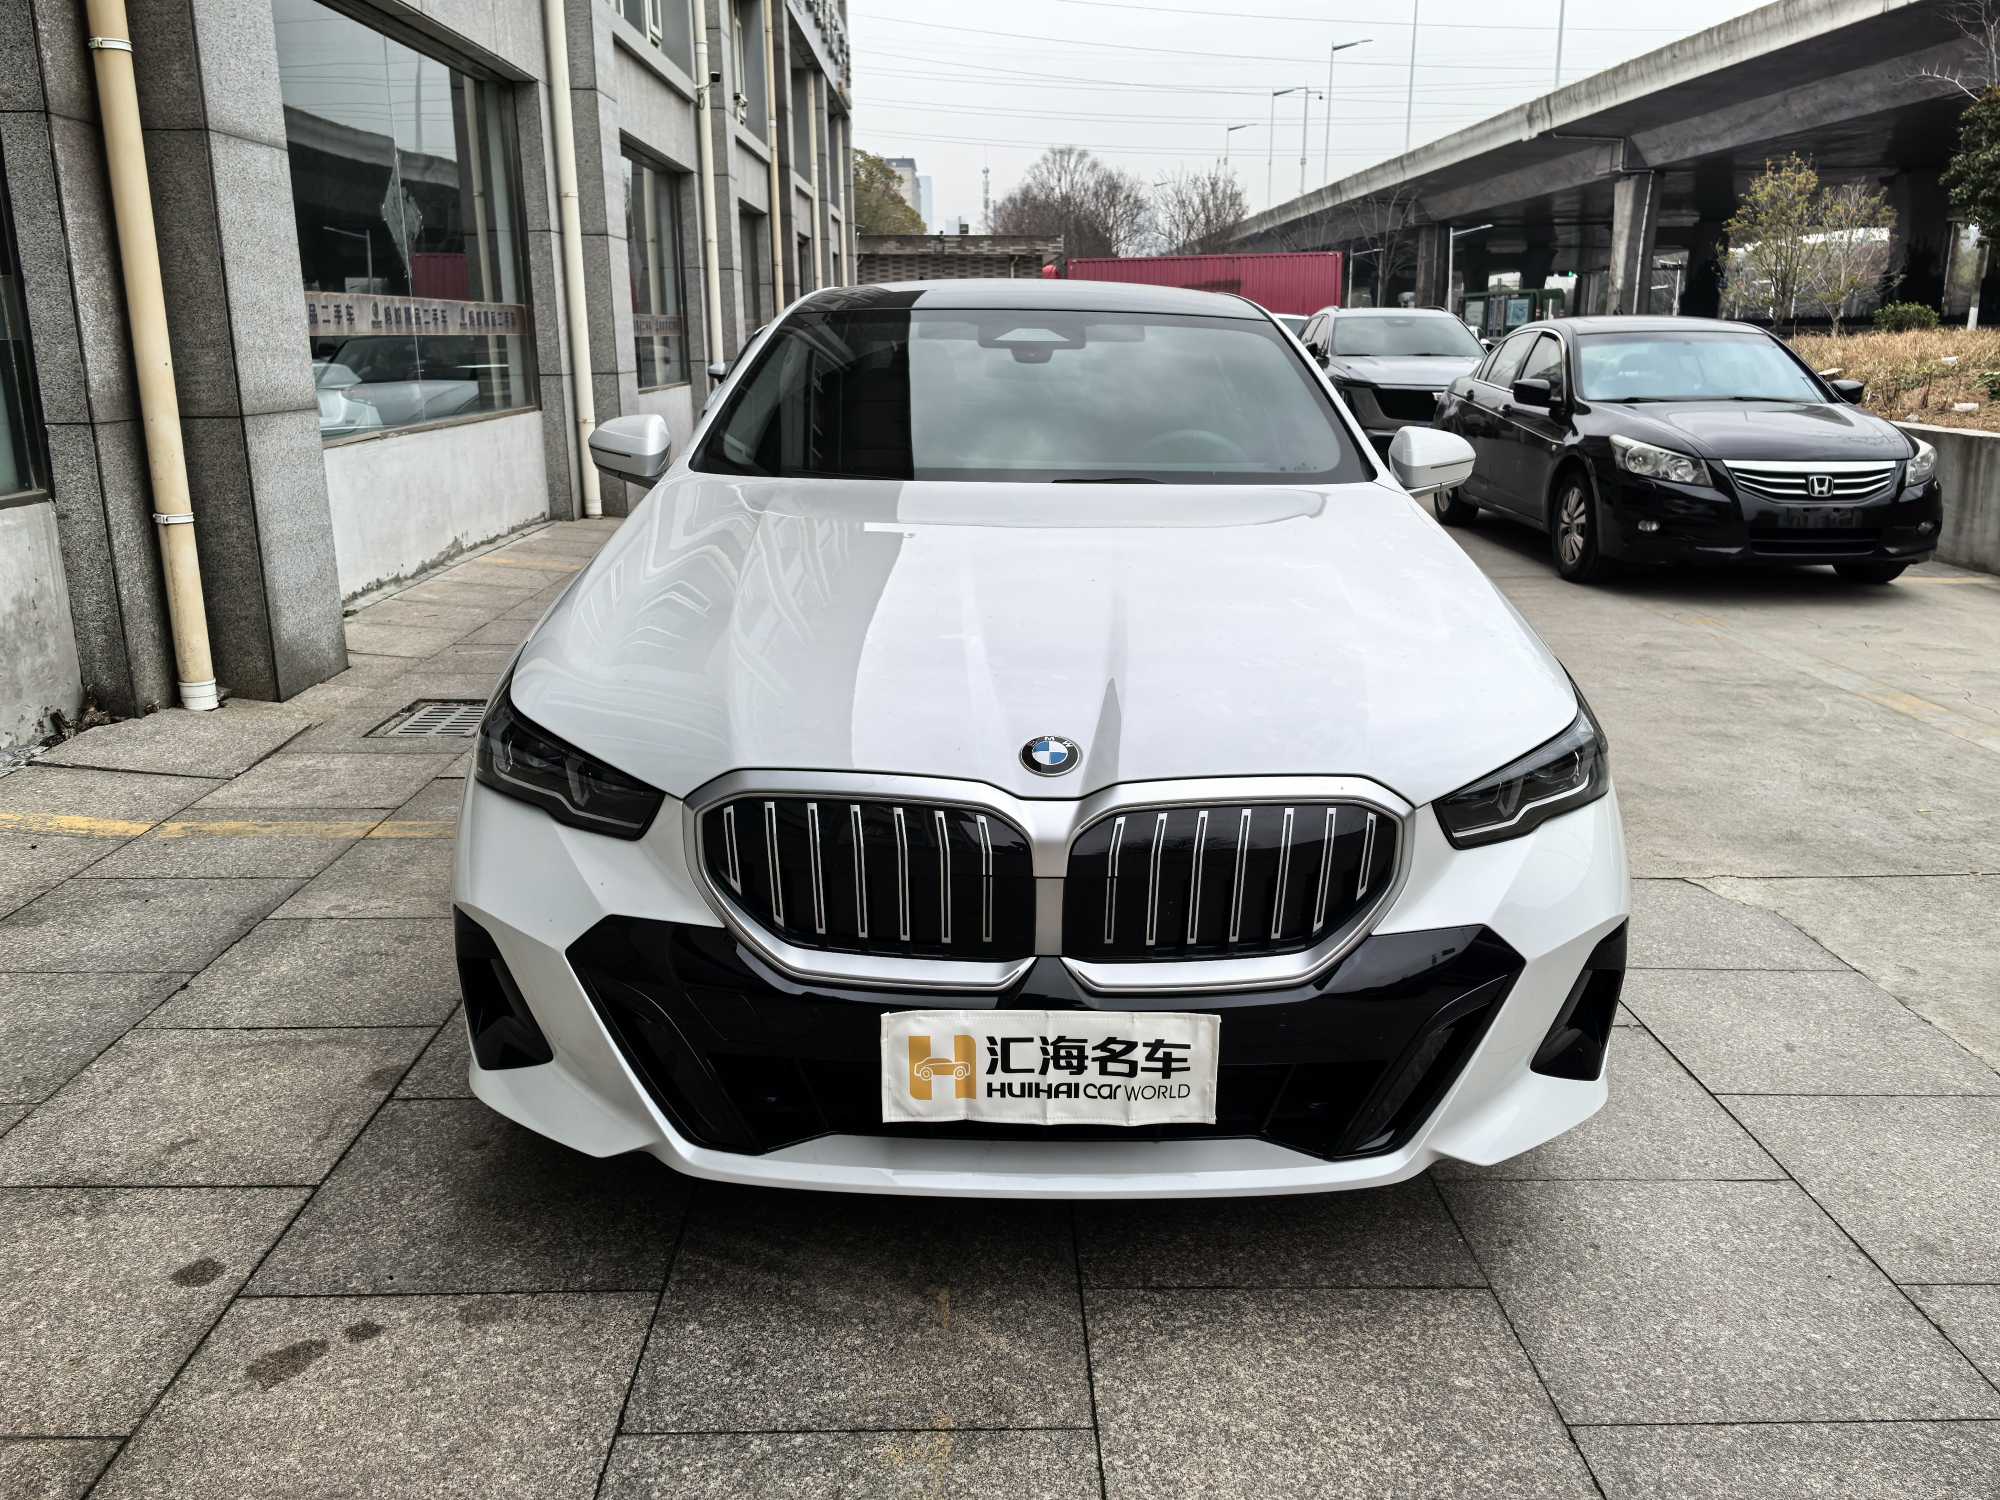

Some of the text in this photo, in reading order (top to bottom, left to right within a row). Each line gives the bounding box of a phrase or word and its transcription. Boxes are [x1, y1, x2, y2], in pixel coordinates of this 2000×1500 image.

[986, 1035, 1191, 1079] 汇海名车
[987, 1082, 1191, 1100] HUIHAI car WORLD
